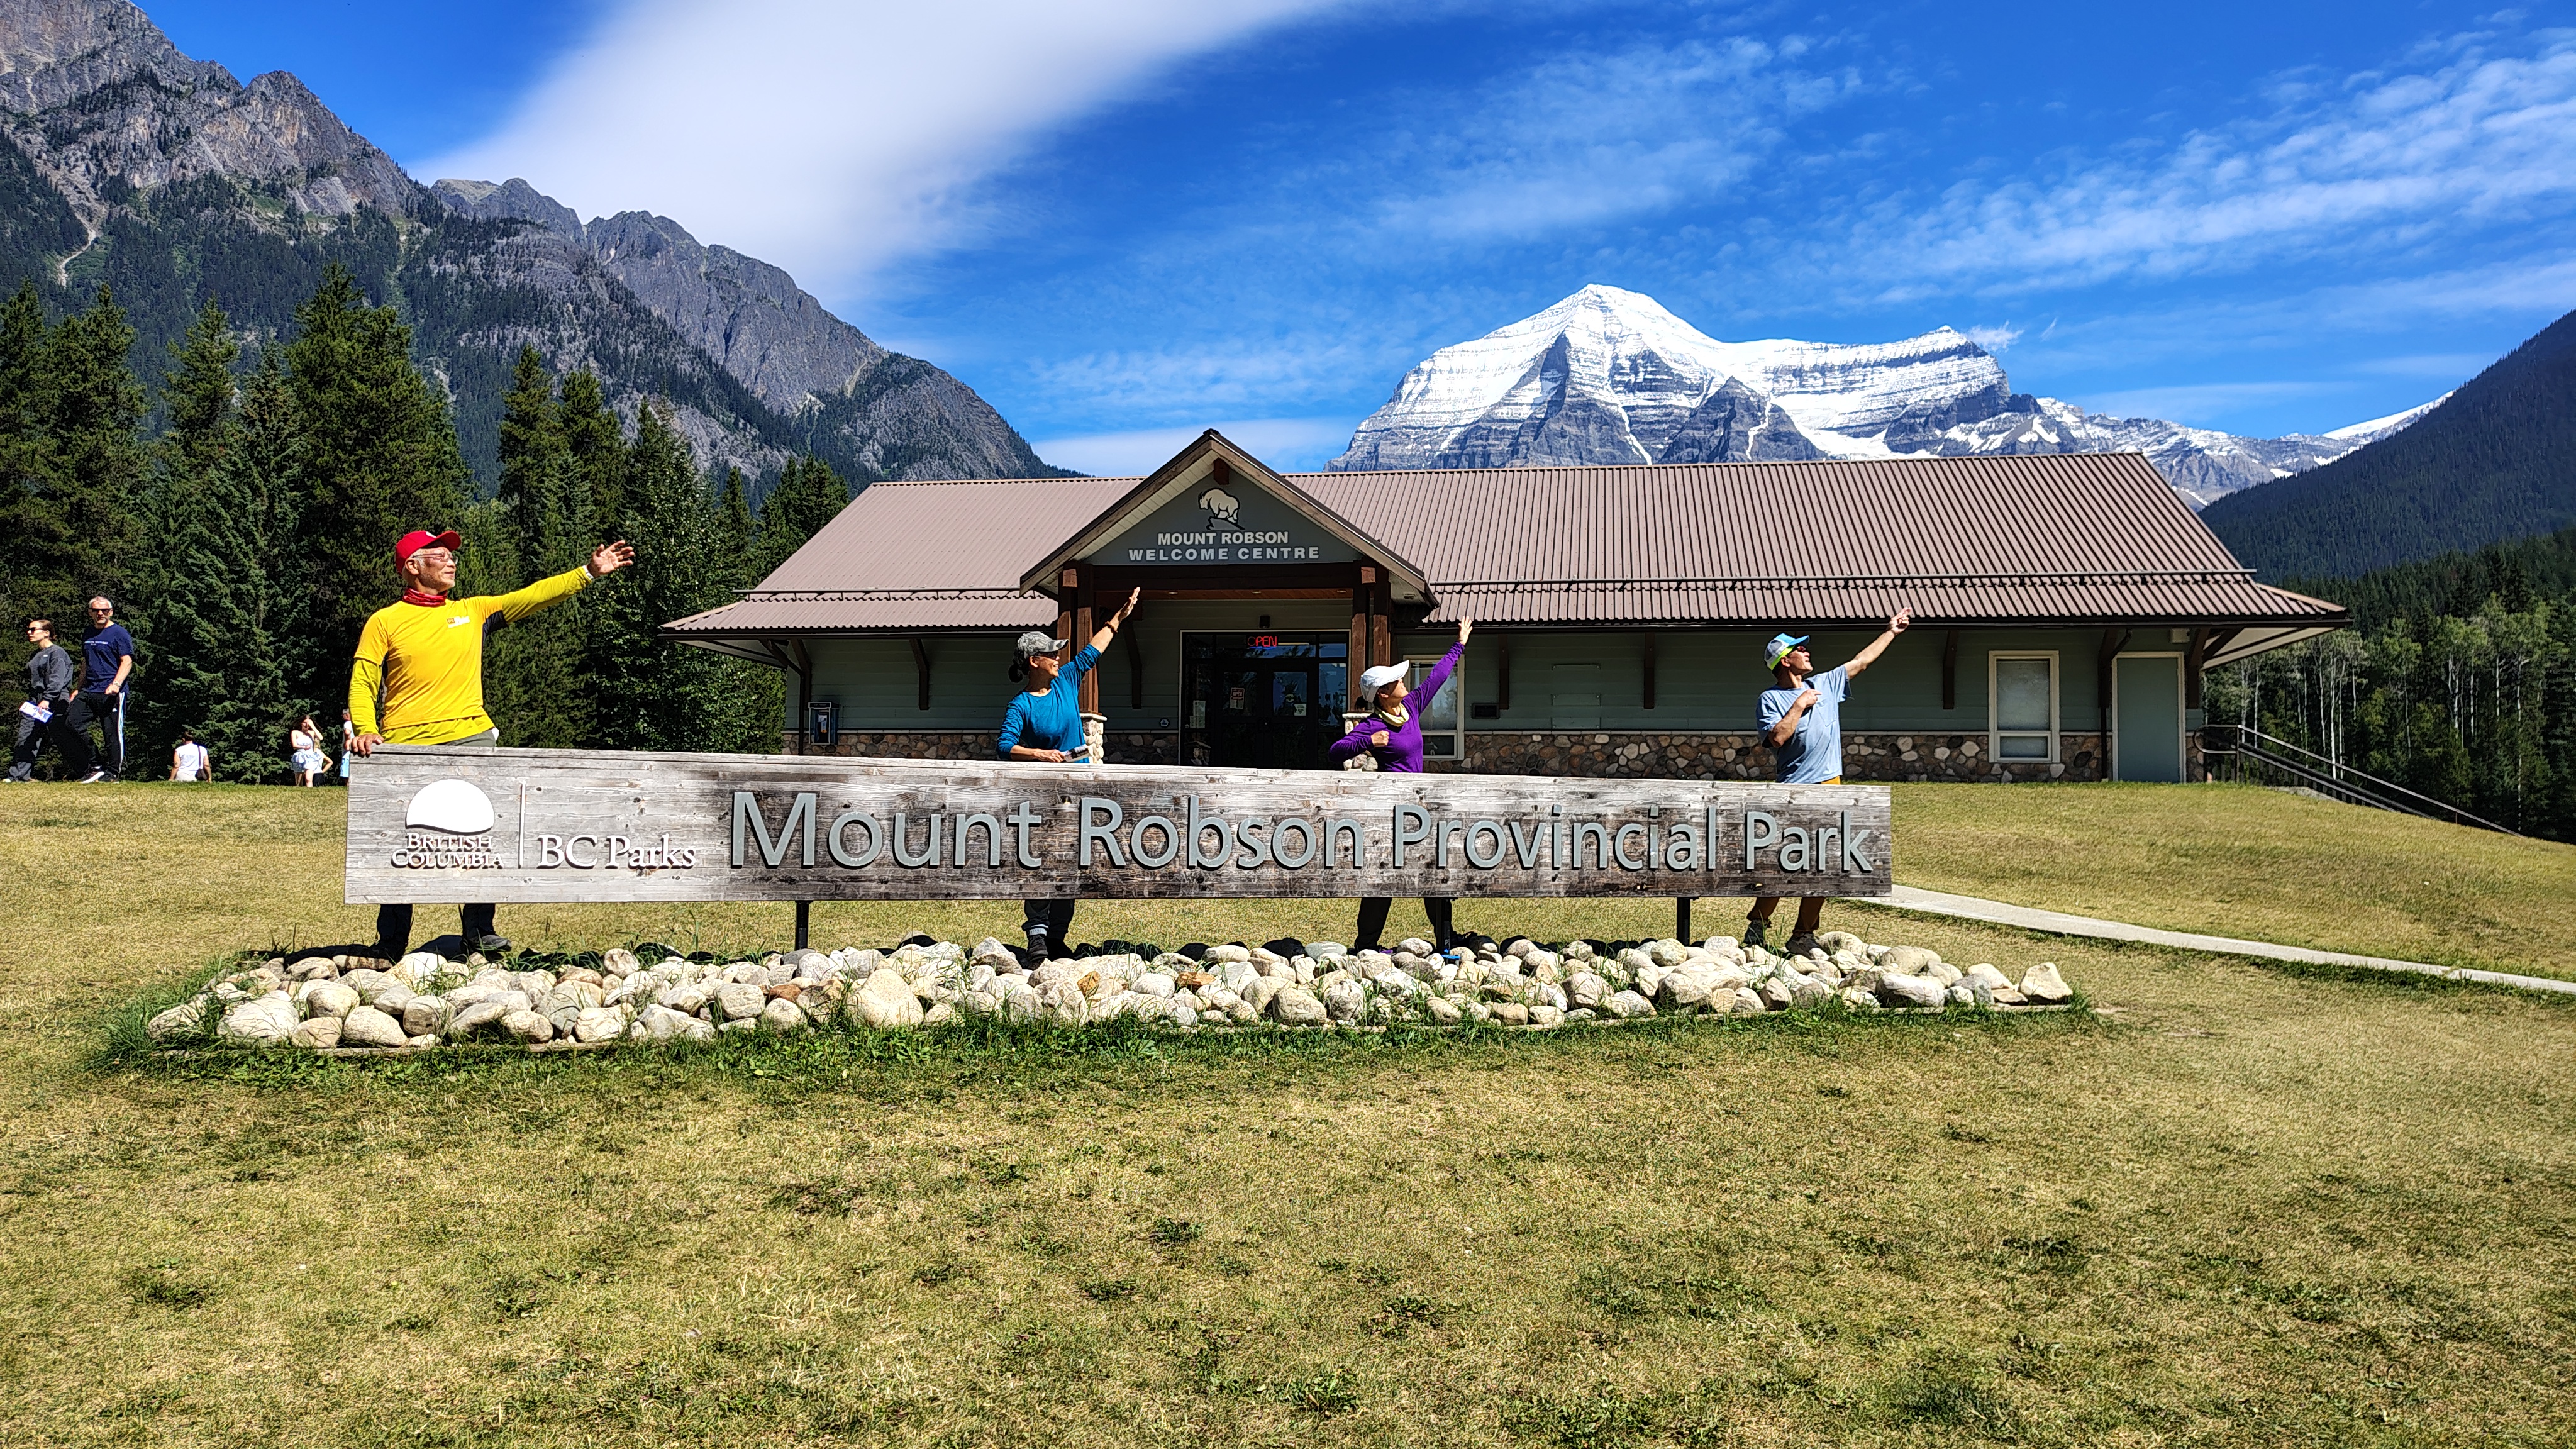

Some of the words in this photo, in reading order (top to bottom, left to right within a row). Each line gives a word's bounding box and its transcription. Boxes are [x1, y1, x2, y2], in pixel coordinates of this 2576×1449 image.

[1158, 533, 1216, 545] MOUNT
[1221, 531, 1289, 545] ROBSON
[1128, 548, 1228, 561] WELCOME
[1238, 547, 1319, 560] CENTRE
[1247, 636, 1277, 647] OPEN
[731, 792, 1043, 869] Mount
[1079, 795, 1364, 870] Robson
[1393, 804, 1716, 870] Provincial
[1745, 810, 1874, 873] Park
[406, 833, 494, 852] BRITISH
[538, 834, 598, 869] BC
[605, 833, 697, 869] Parks
[391, 848, 504, 869] COLUMBIA
